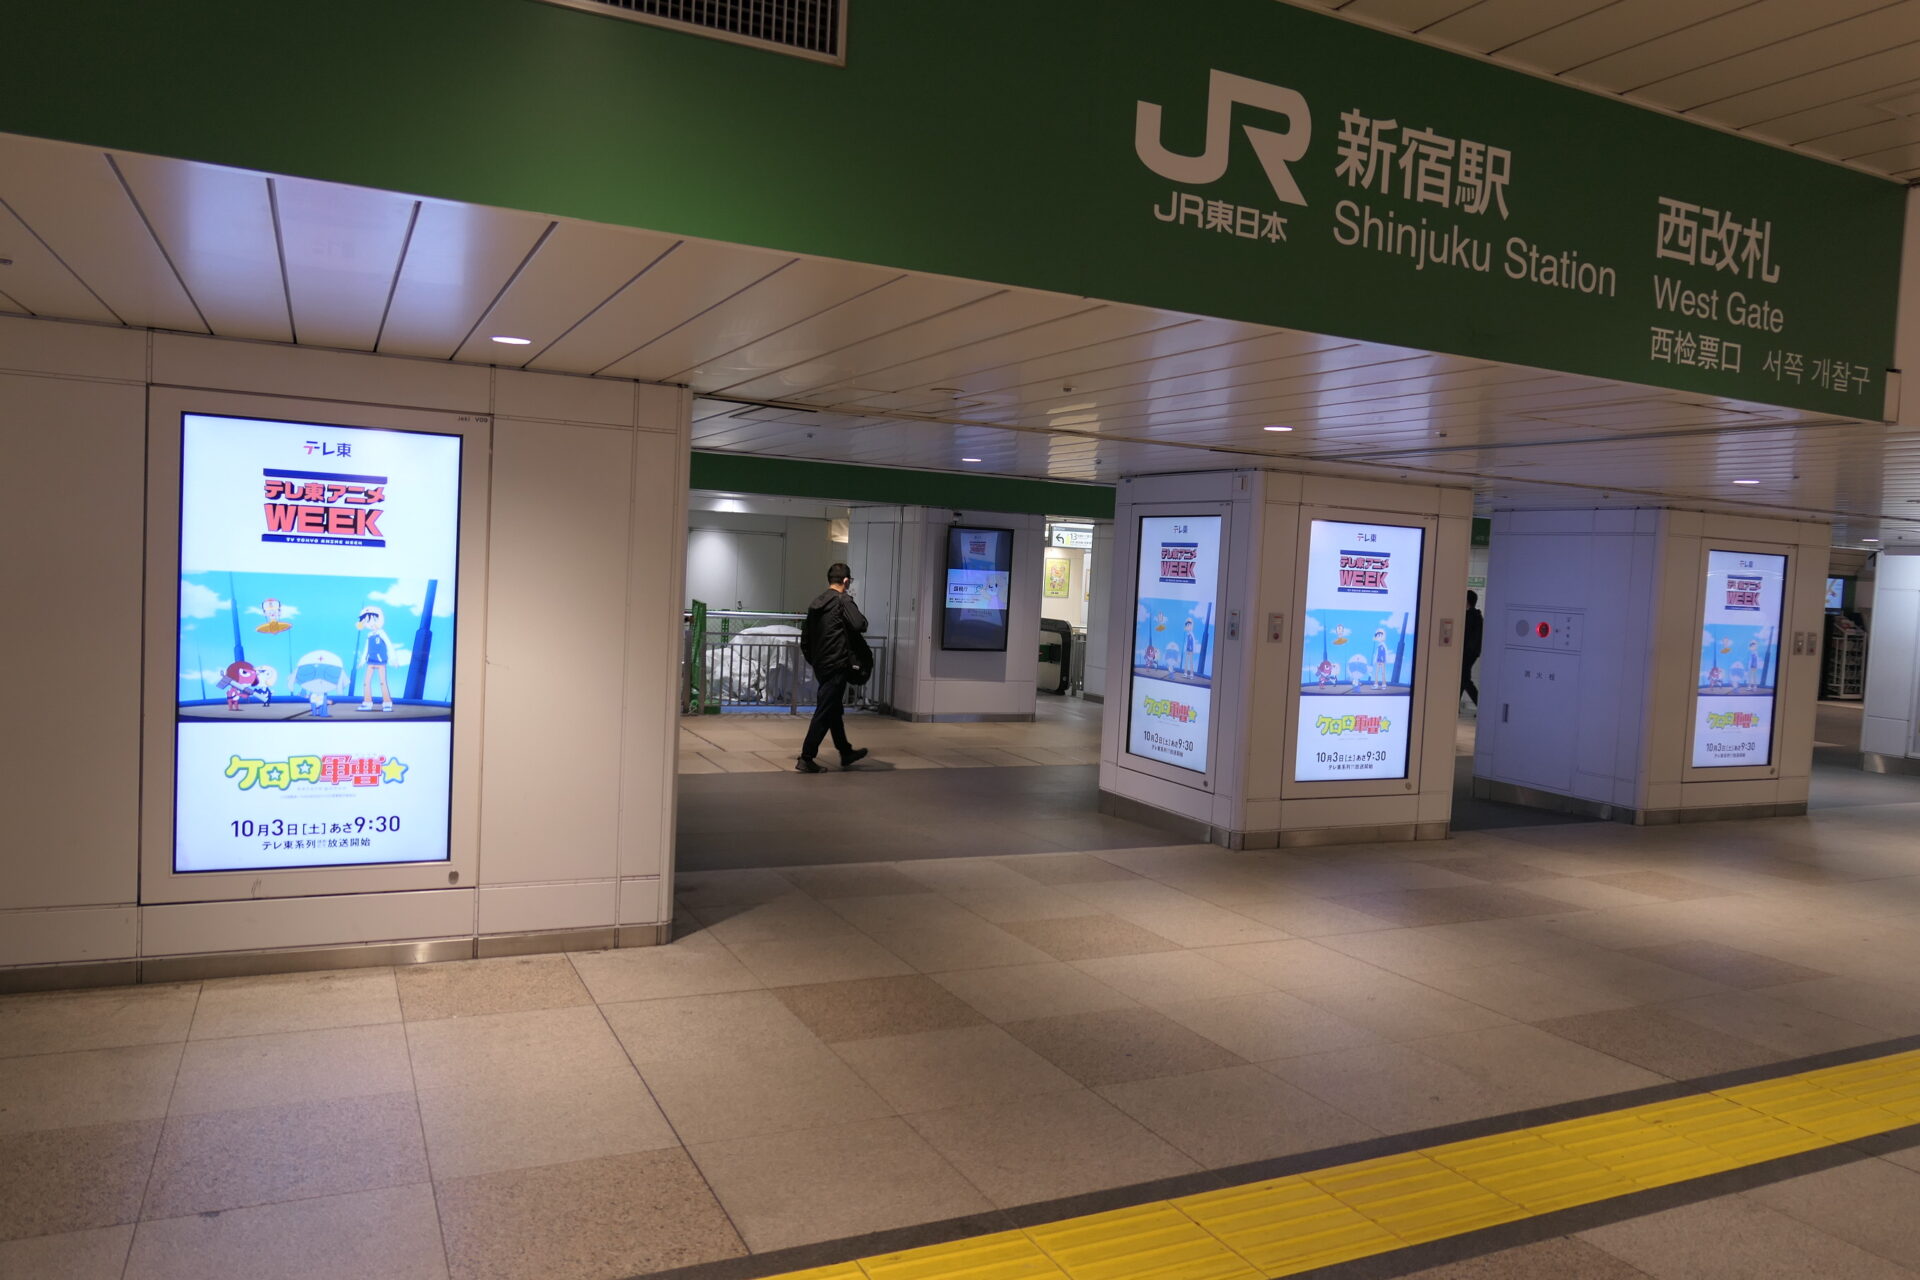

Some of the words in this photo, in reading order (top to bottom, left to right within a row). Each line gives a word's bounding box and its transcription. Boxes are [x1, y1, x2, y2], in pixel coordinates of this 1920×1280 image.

[1135, 68, 1312, 206] JR
[1334, 108, 1512, 220] 新宿駅
[1154, 191, 1288, 243] JR東日本
[1333, 200, 1491, 272] Shinjuku
[1504, 237, 1616, 297] Station
[1656, 196, 1781, 284] 西改札
[1654, 274, 1719, 321] West
[1726, 291, 1784, 333] Gate
[1650, 326, 1742, 373] 西检票口
[1762, 350, 1804, 385] 서쪽
[1811, 358, 1871, 395] 개찰구
[303, 440, 352, 458] テレ東
[264, 479, 386, 505] テレ東アニメ
[264, 503, 384, 537] WEEK
[1357, 533, 1377, 542] テレ東
[1160, 560, 1196, 578] WEEK
[1339, 569, 1388, 588] WEEK
[1726, 591, 1760, 606] WEEK
